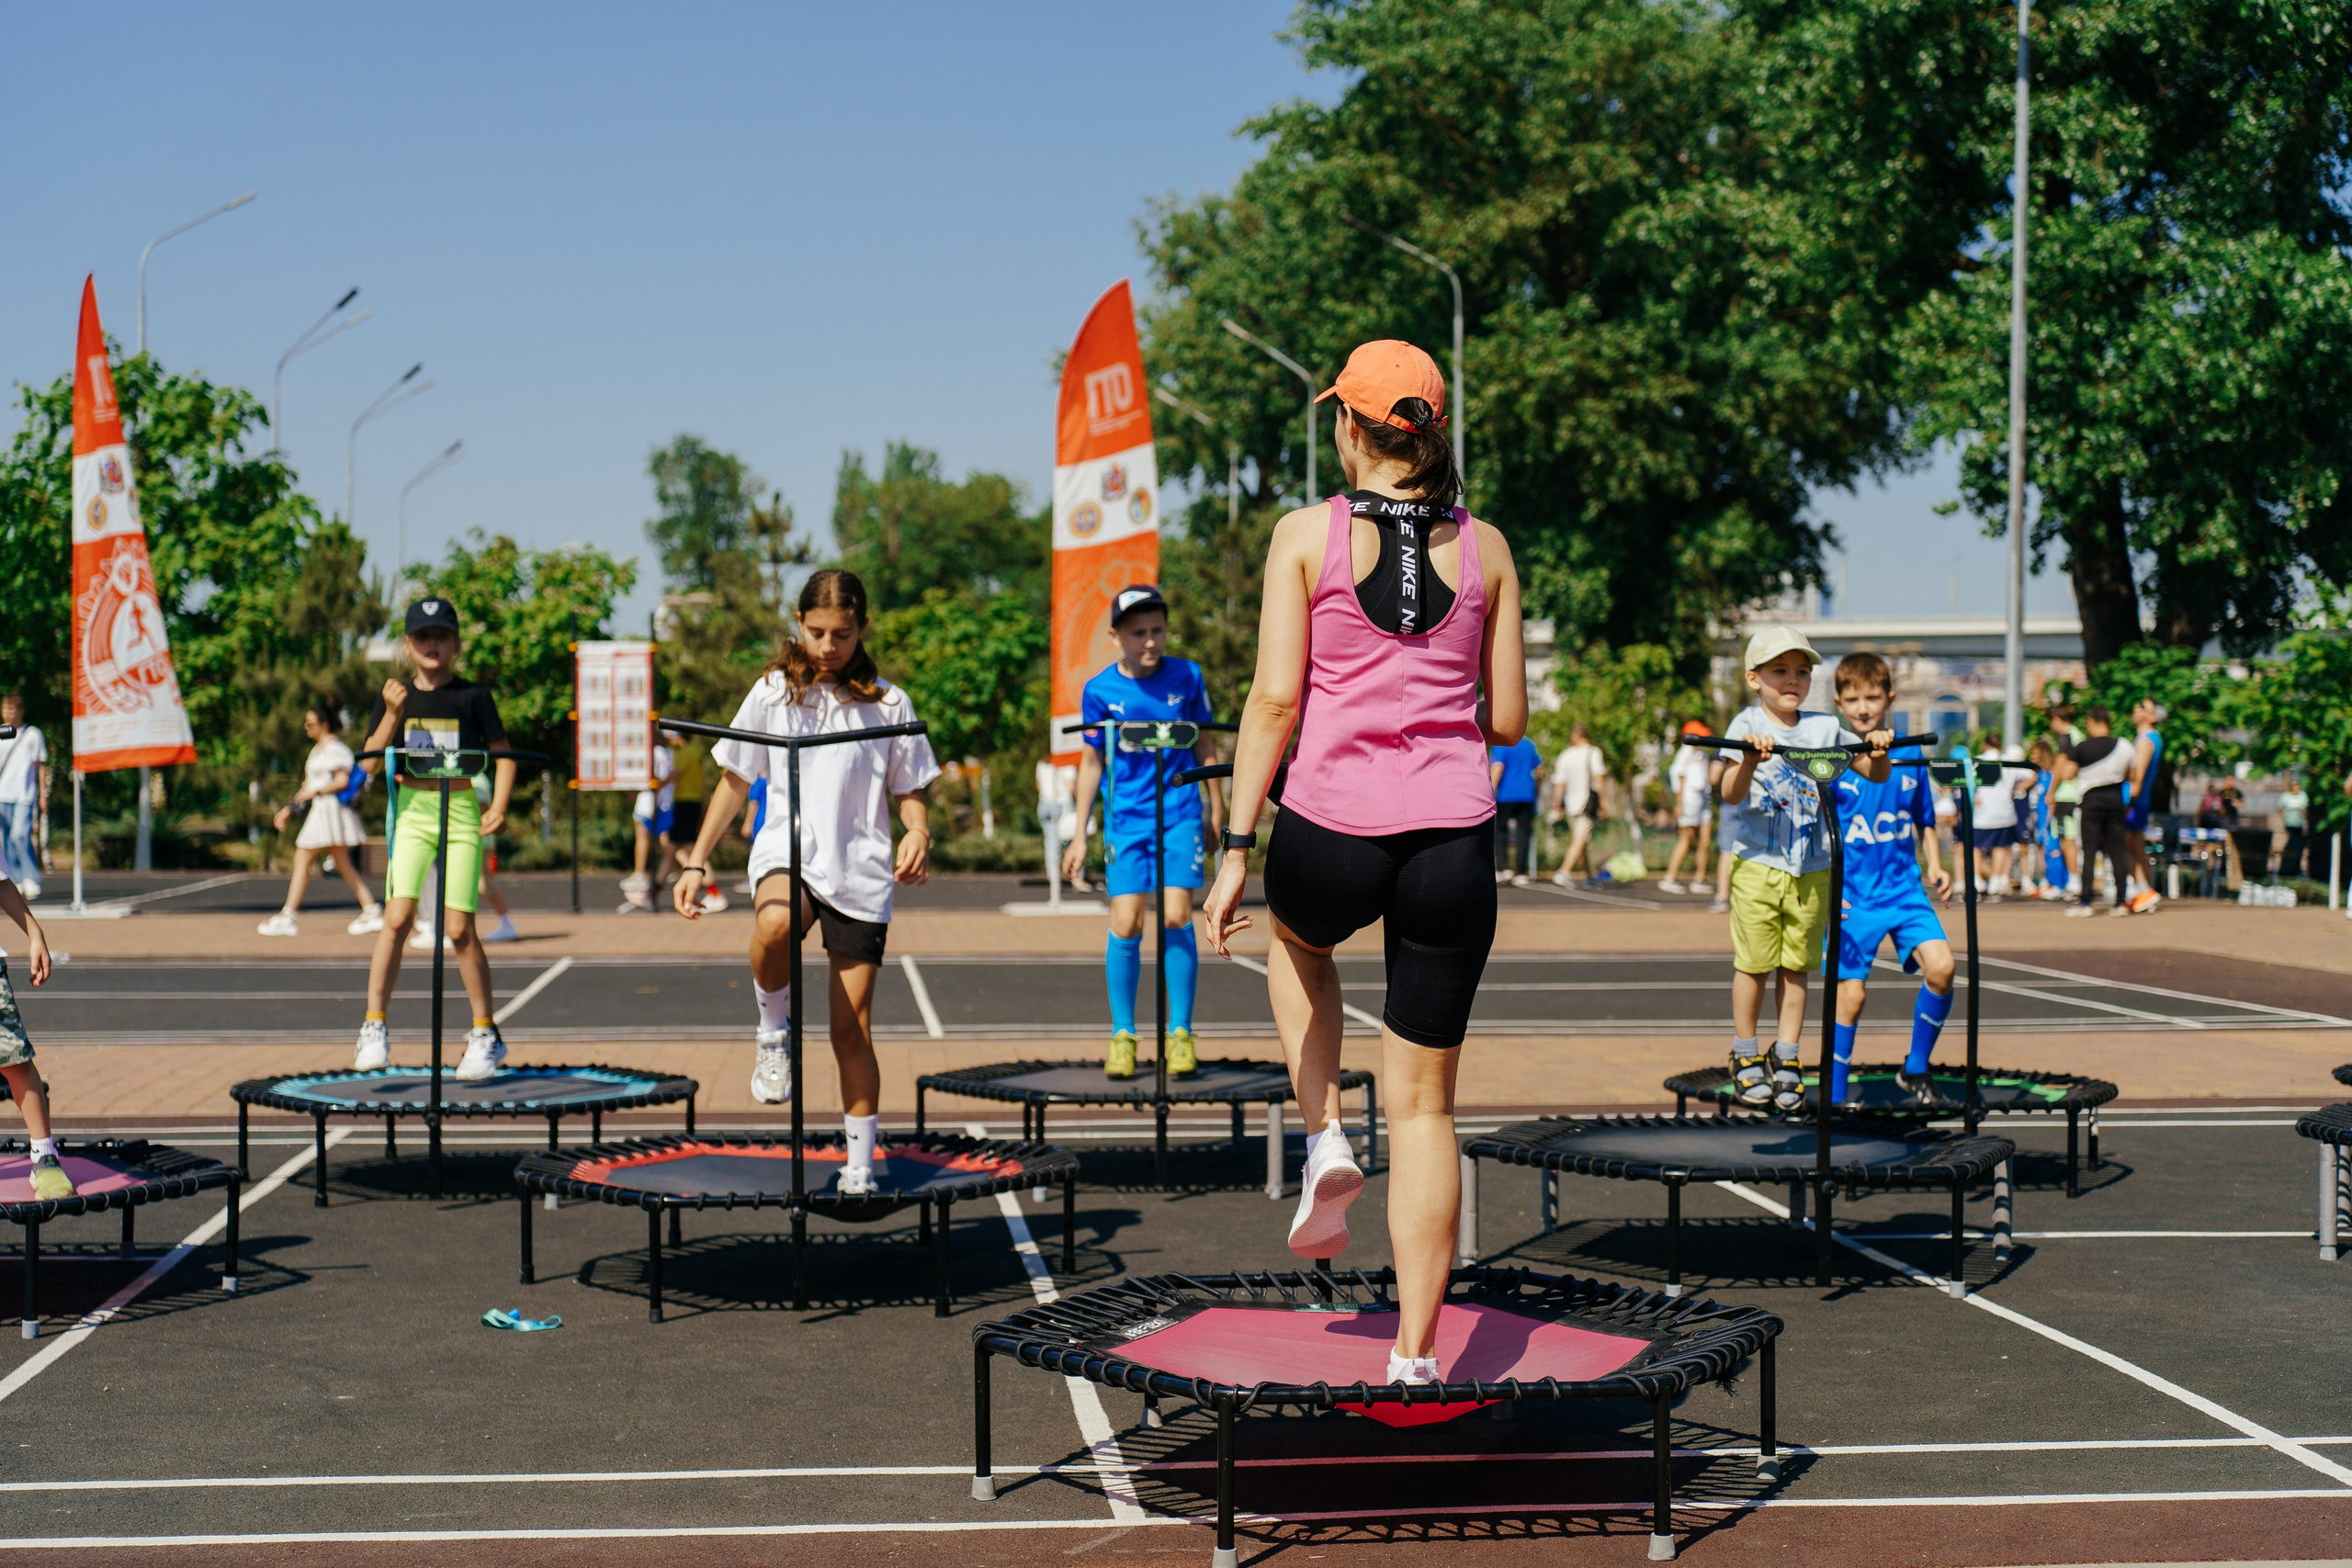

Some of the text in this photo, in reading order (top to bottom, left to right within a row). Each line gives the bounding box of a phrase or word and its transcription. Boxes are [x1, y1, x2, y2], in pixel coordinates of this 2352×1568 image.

[1380, 501, 1430, 517] NIKE
[1401, 545, 1417, 601] NIKE
[1789, 750, 1848, 761] SkyJumping
